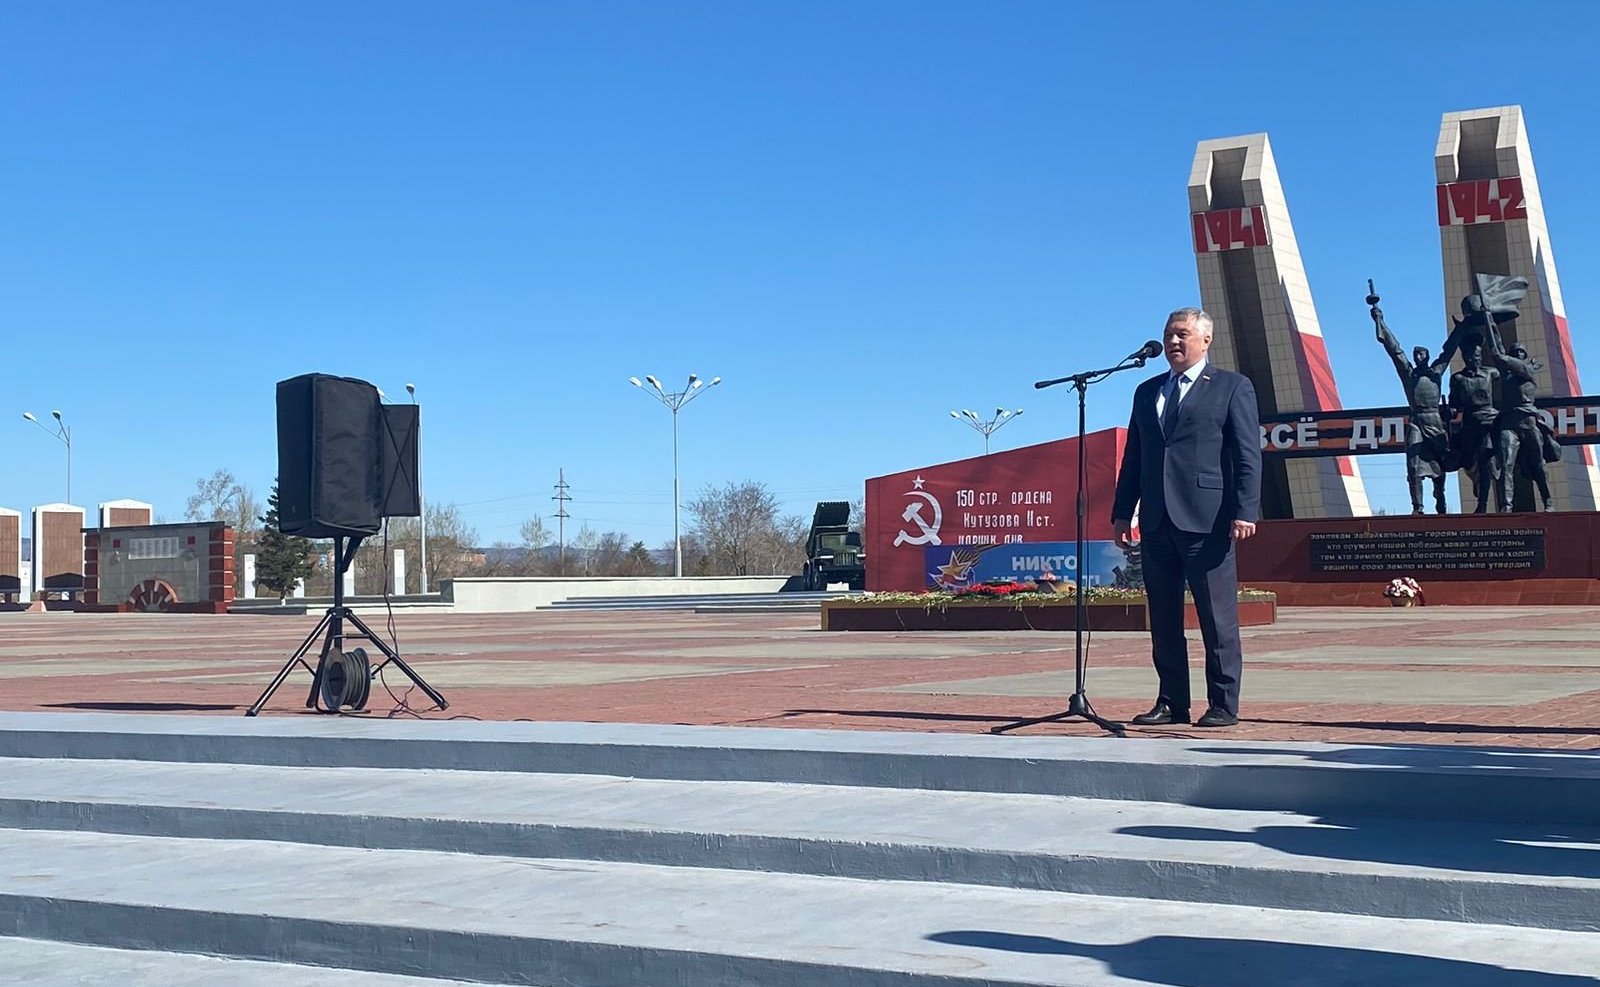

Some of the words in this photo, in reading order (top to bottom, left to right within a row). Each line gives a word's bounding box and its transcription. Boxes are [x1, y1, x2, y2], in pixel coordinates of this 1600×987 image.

[1437, 177, 1528, 226] 1942
[1193, 206, 1270, 253] 1941
[1349, 417, 1405, 450] ДЛ
[956, 490, 974, 507] 150
[1012, 555, 1077, 571] НИКТО
